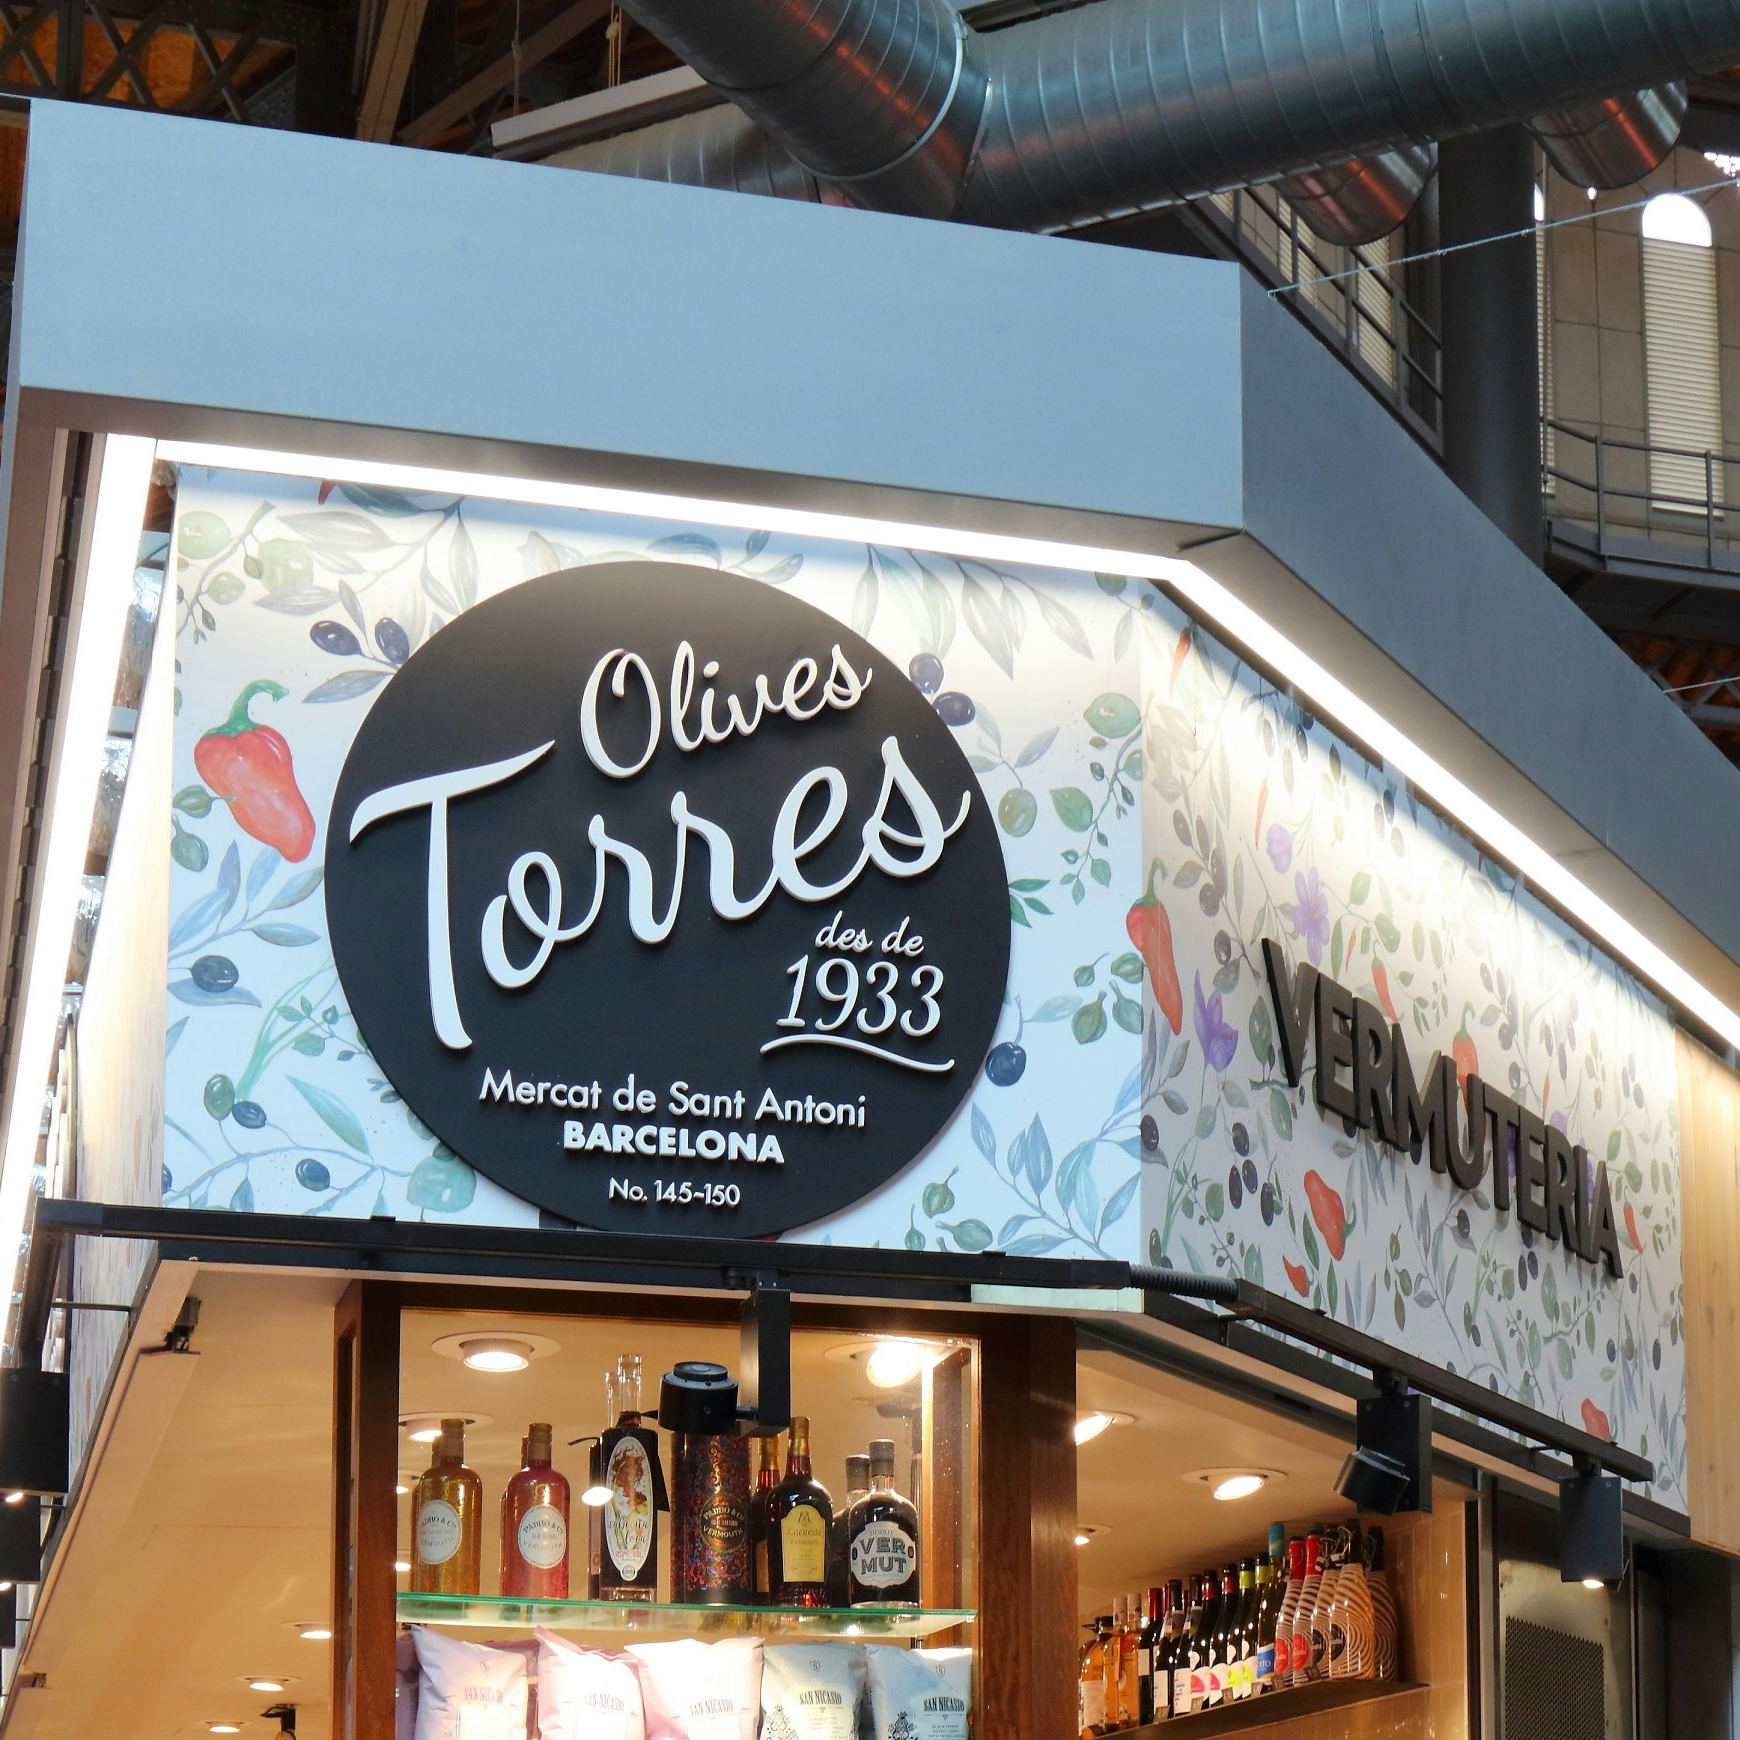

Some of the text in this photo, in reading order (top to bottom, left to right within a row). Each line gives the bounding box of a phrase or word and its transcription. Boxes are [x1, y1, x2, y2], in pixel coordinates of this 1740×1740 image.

[580, 641, 873, 778] Olives
[350, 736, 971, 1049] Torres
[777, 954, 944, 1037] 1933
[479, 1069, 866, 1128] Mercat de Sant Antoni
[1262, 937, 1623, 1279] VERMUTERIA
[563, 1120, 785, 1165] BARCELONA
[608, 1178, 741, 1209] No. 145-150
[703, 1525, 744, 1539] VERMOUTH
[860, 1537, 906, 1556] VER
[861, 1556, 907, 1576] MUT
[464, 1687, 479, 1700] SAN
[584, 1693, 625, 1713] SAN NICASIO
[800, 1689, 842, 1705] SAN NICASIO
[689, 1699, 734, 1716] SAN NICASIO
[923, 1696, 965, 1713] SAN NICASIO
